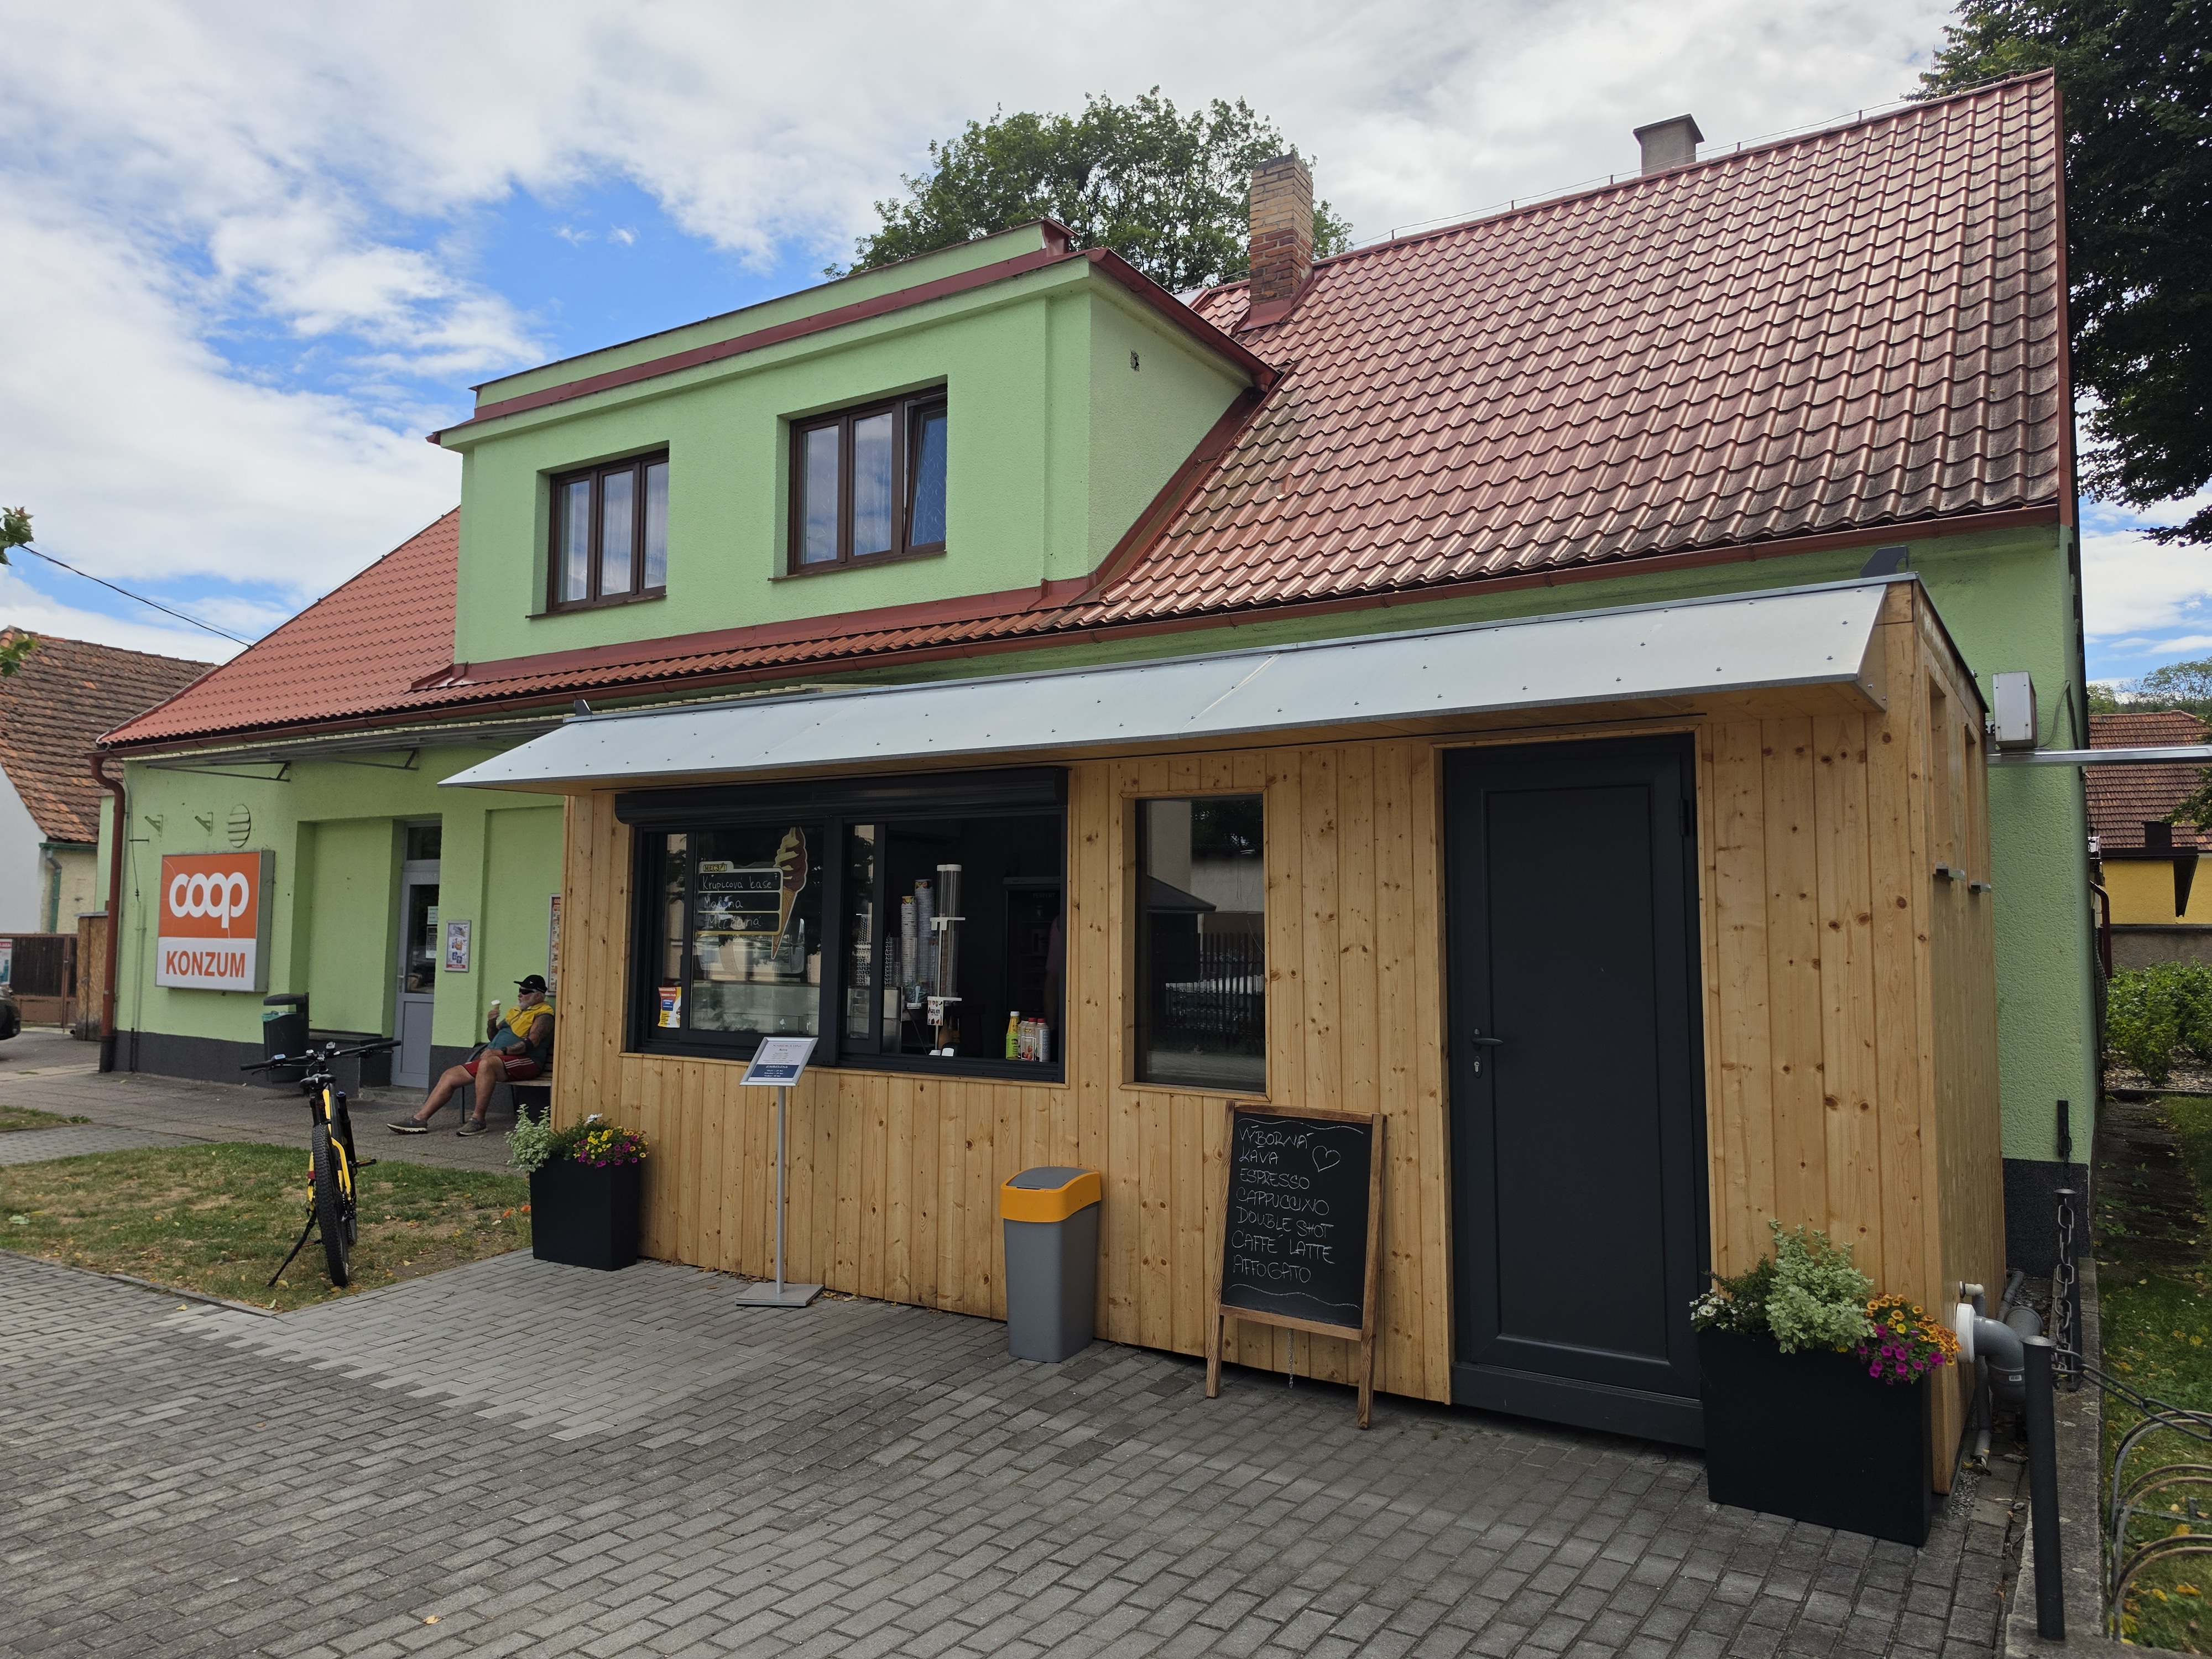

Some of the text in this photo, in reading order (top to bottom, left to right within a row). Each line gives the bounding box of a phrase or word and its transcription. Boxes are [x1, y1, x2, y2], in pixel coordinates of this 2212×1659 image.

[169, 872, 249, 928] coop
[166, 950, 246, 978] KONZUM
[1239, 1125, 1314, 1149] VÝBORNÁ
[1239, 1146, 1279, 1165] KÁVA
[1240, 1168, 1310, 1190] ESPRESSO
[1236, 1187, 1329, 1216] CAPPUCCINO
[1236, 1206, 1334, 1239] DOUBLE SHOT
[1290, 1238, 1335, 1264] LATTE
[1233, 1254, 1311, 1283] AFFOGATO
